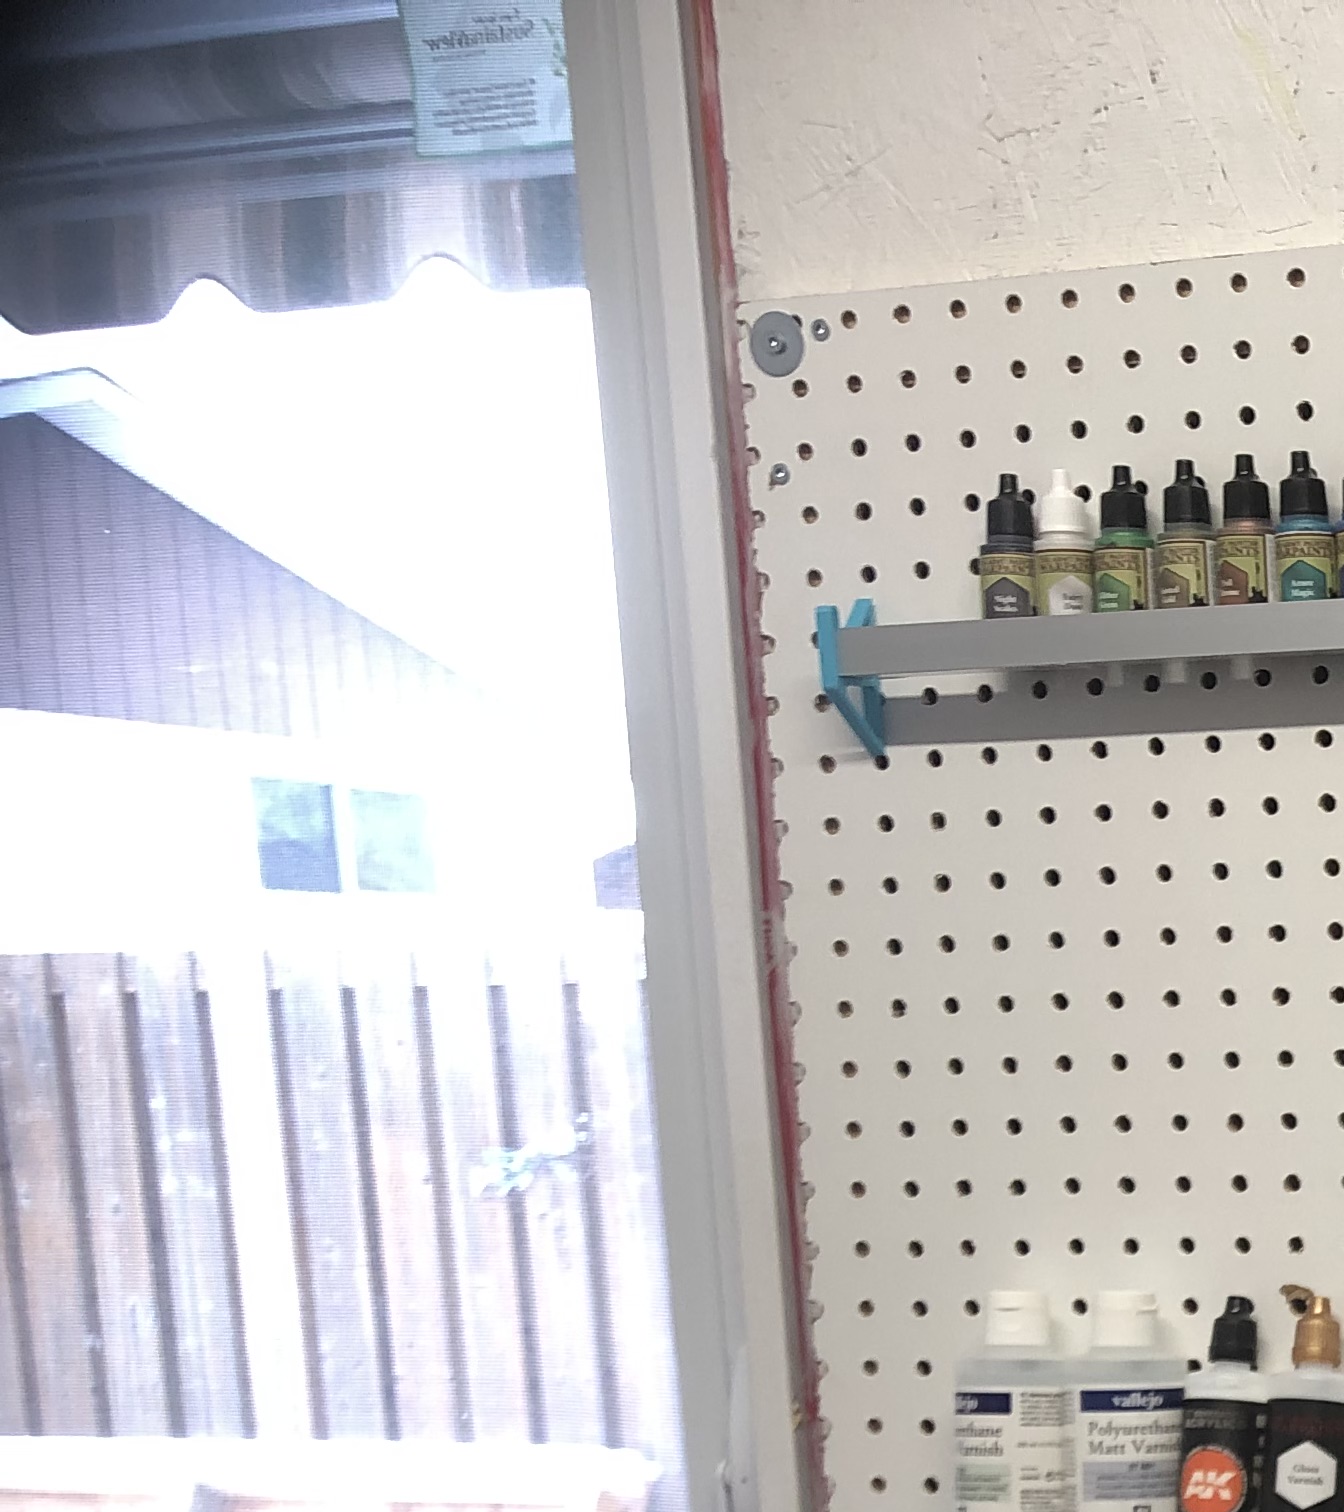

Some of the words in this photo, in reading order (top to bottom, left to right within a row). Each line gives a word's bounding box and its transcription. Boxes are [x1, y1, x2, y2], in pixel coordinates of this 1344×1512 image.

[1112, 1393, 1163, 1409] vallejo
[1089, 1441, 1125, 1456] Matt
[1293, 1464, 1319, 1474] Gloss
[1287, 1477, 1323, 1486] Varnish
